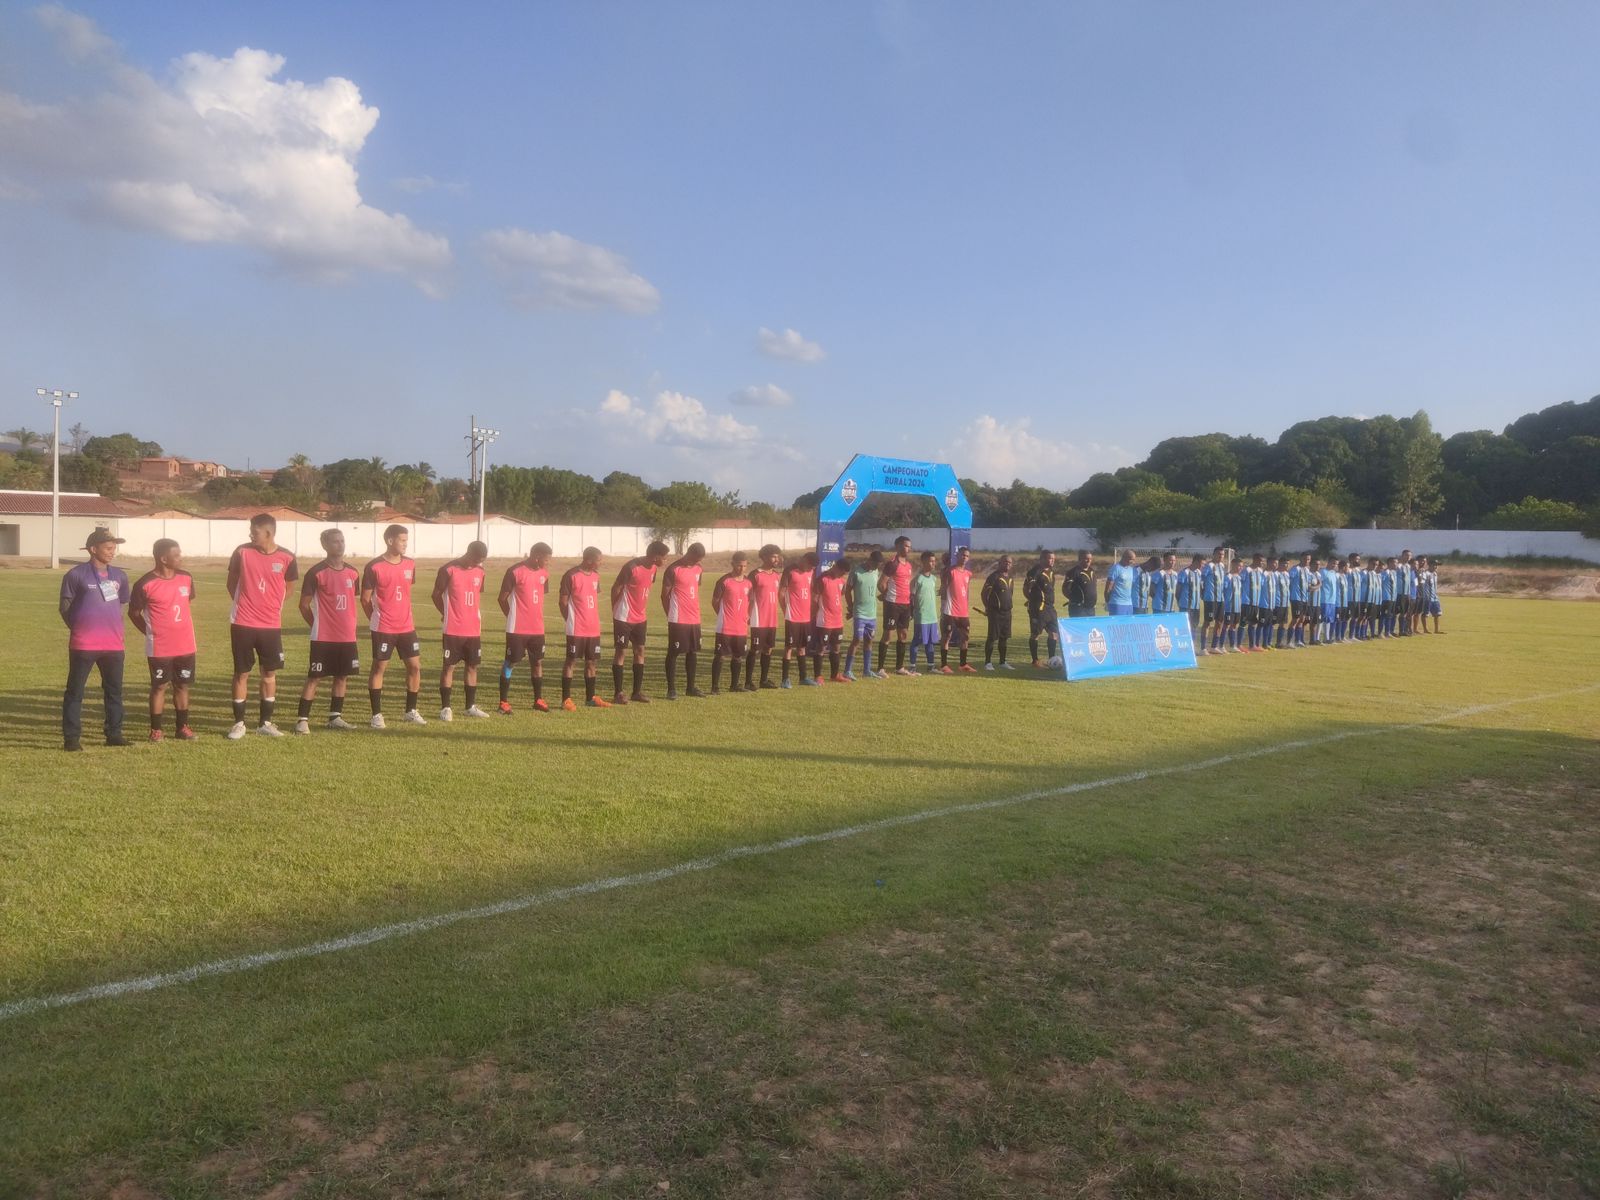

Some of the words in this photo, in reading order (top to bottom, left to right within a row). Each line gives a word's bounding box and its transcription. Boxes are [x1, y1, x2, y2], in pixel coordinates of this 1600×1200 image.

[882, 464, 929, 478] CAMPEONATO
[884, 477, 908, 487] RURAL
[908, 479, 926, 488] 2024
[258, 577, 265, 594] 4
[395, 586, 402, 601] 5
[464, 591, 474, 607] 10
[533, 589, 539, 605] 6
[769, 591, 776, 604] 11
[336, 594, 347, 611] 20
[586, 596, 595, 609] 13
[173, 604, 182, 623] 2
[381, 643, 388, 652] 5
[156, 668, 164, 679] 2
[311, 662, 323, 672] 20
